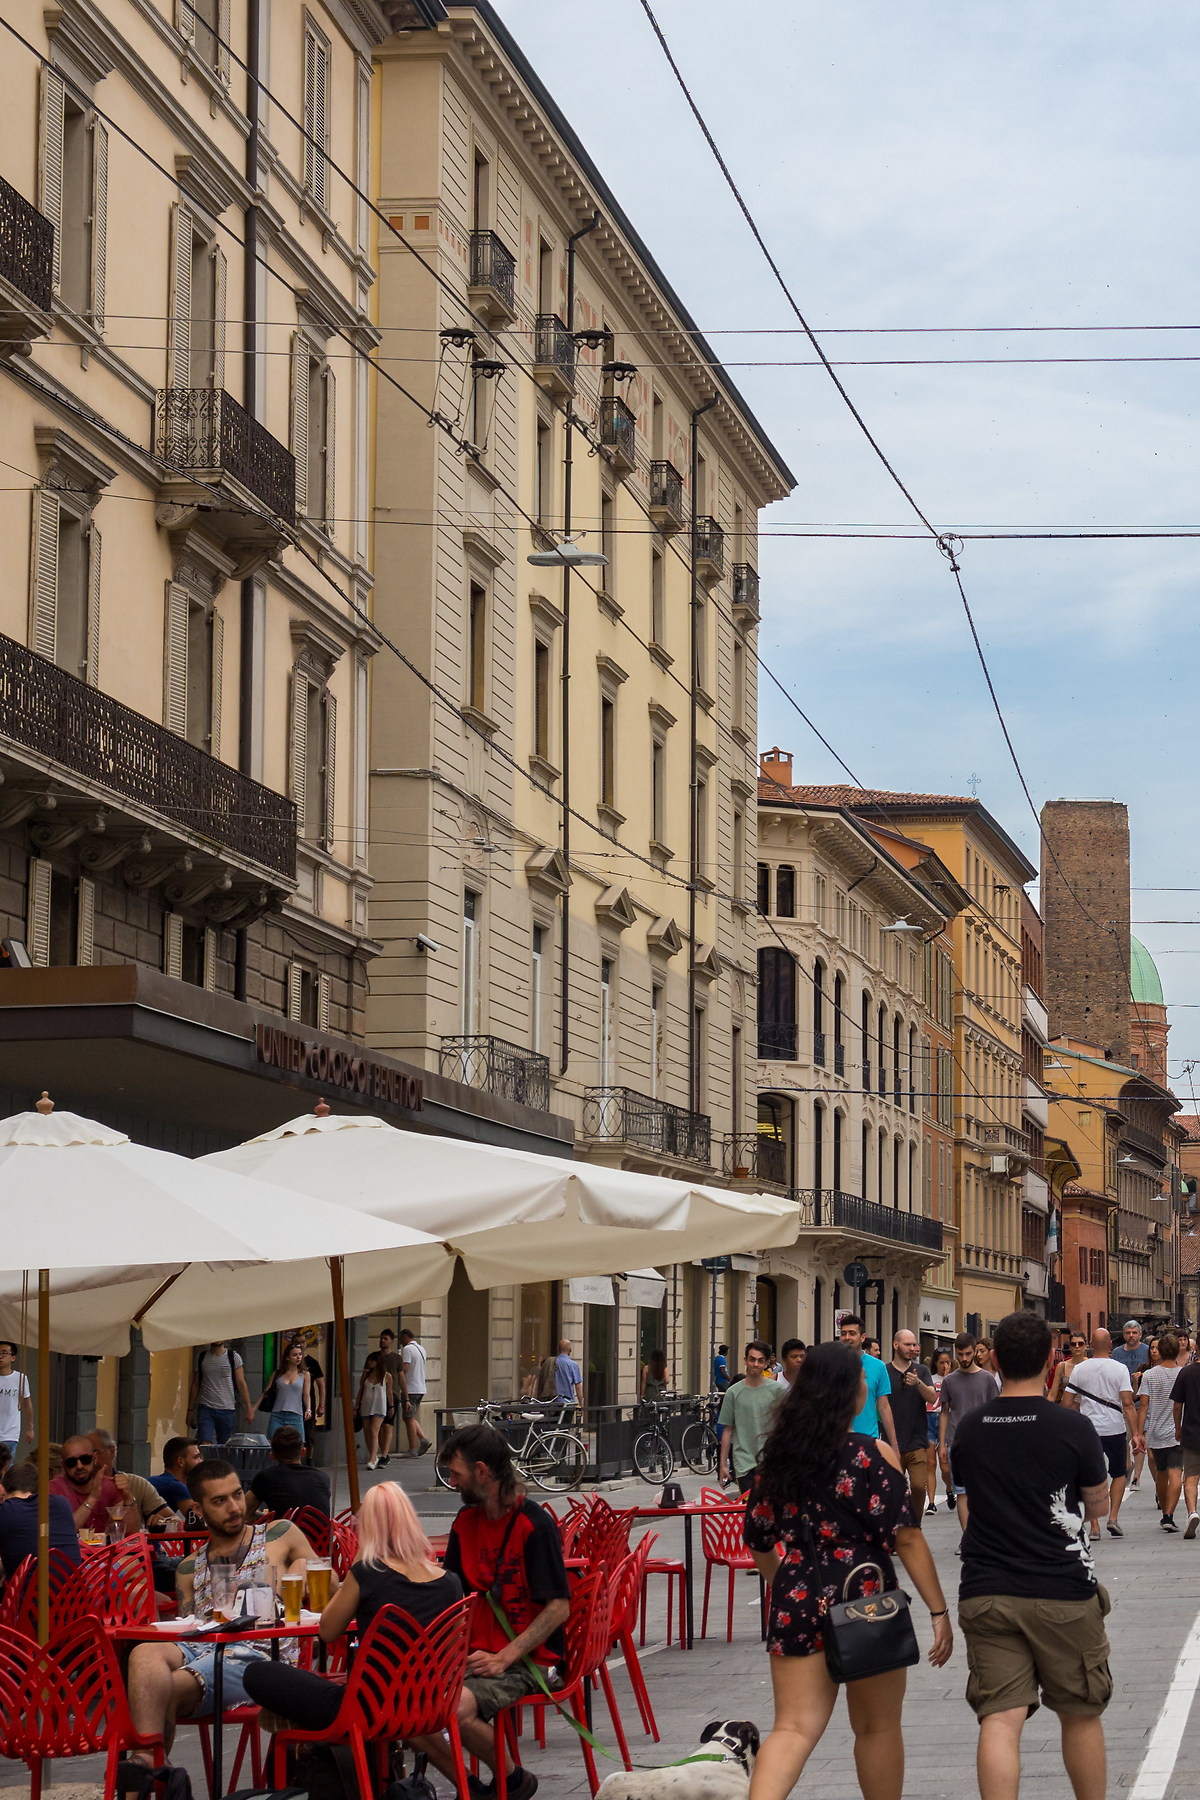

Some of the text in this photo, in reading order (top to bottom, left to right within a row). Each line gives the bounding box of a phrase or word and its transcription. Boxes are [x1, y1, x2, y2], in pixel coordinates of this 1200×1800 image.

[256, 1023, 424, 1111] UNITED COLORS OF BENETTON
[982, 1414, 1038, 1424] MEZZOSANGUE
